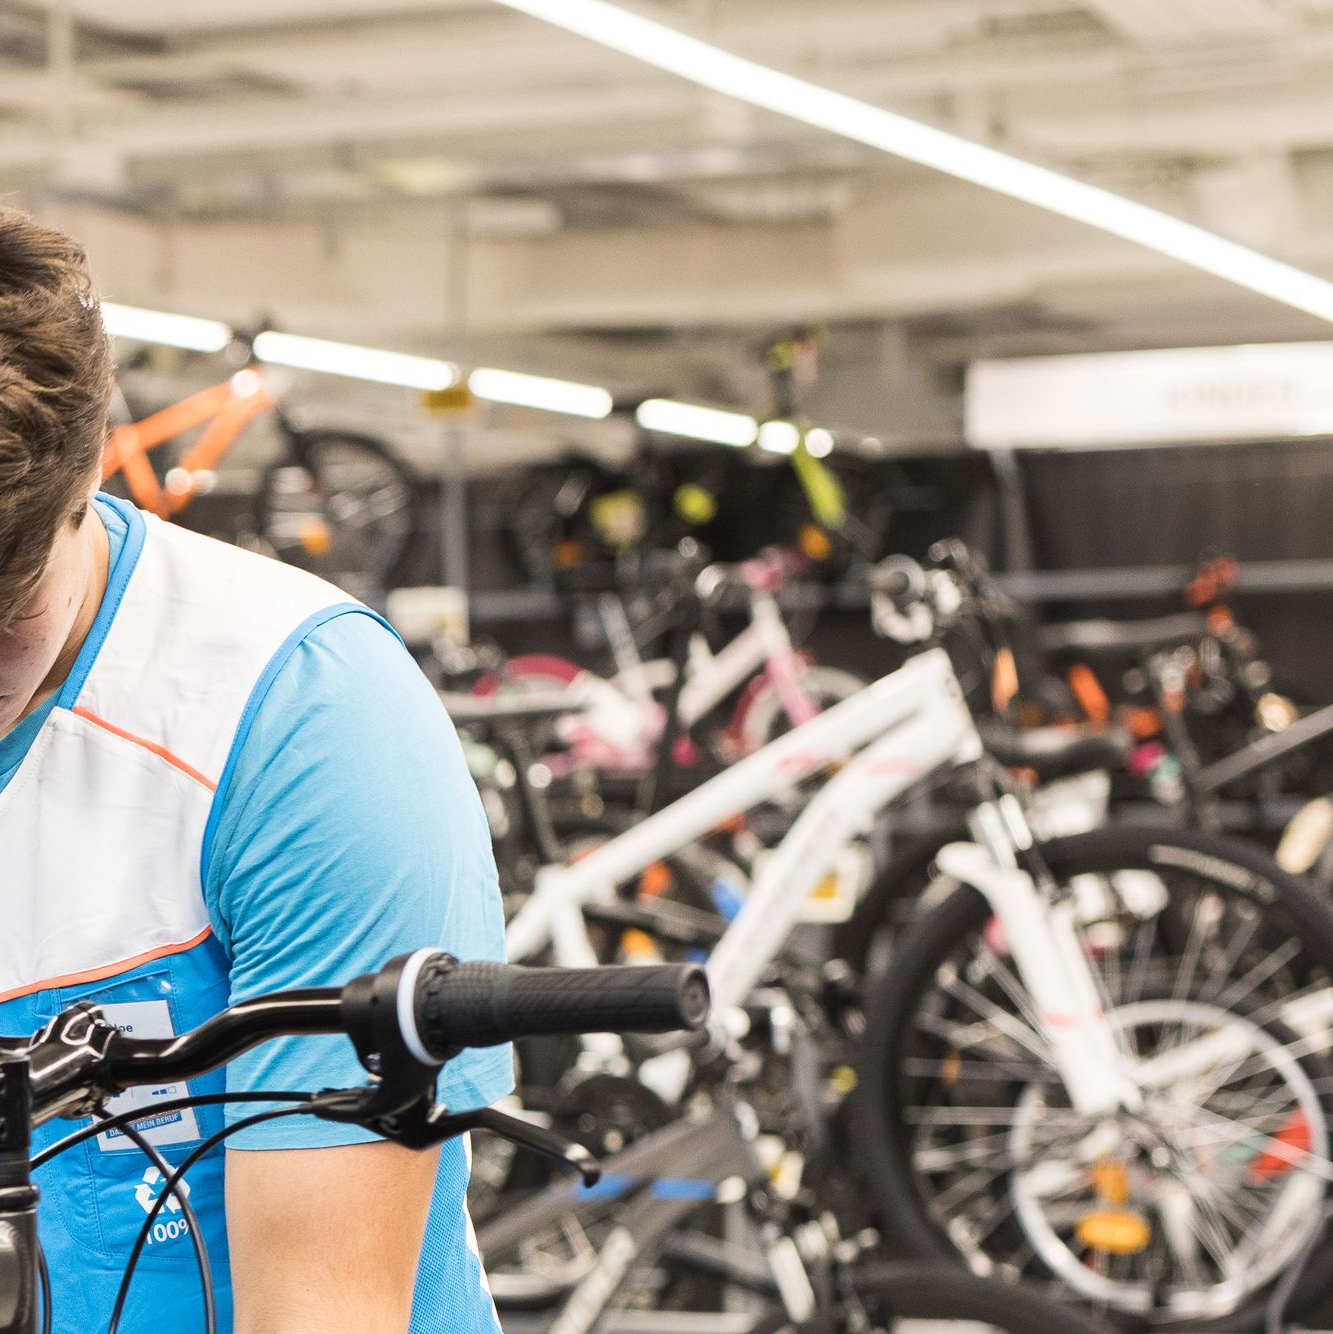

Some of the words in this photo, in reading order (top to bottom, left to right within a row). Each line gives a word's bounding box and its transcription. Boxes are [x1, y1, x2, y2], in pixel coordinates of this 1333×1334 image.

[109, 1128, 124, 1138] DA
[136, 1119, 155, 1131] MEIN
[156, 1113, 179, 1126] BERUF
